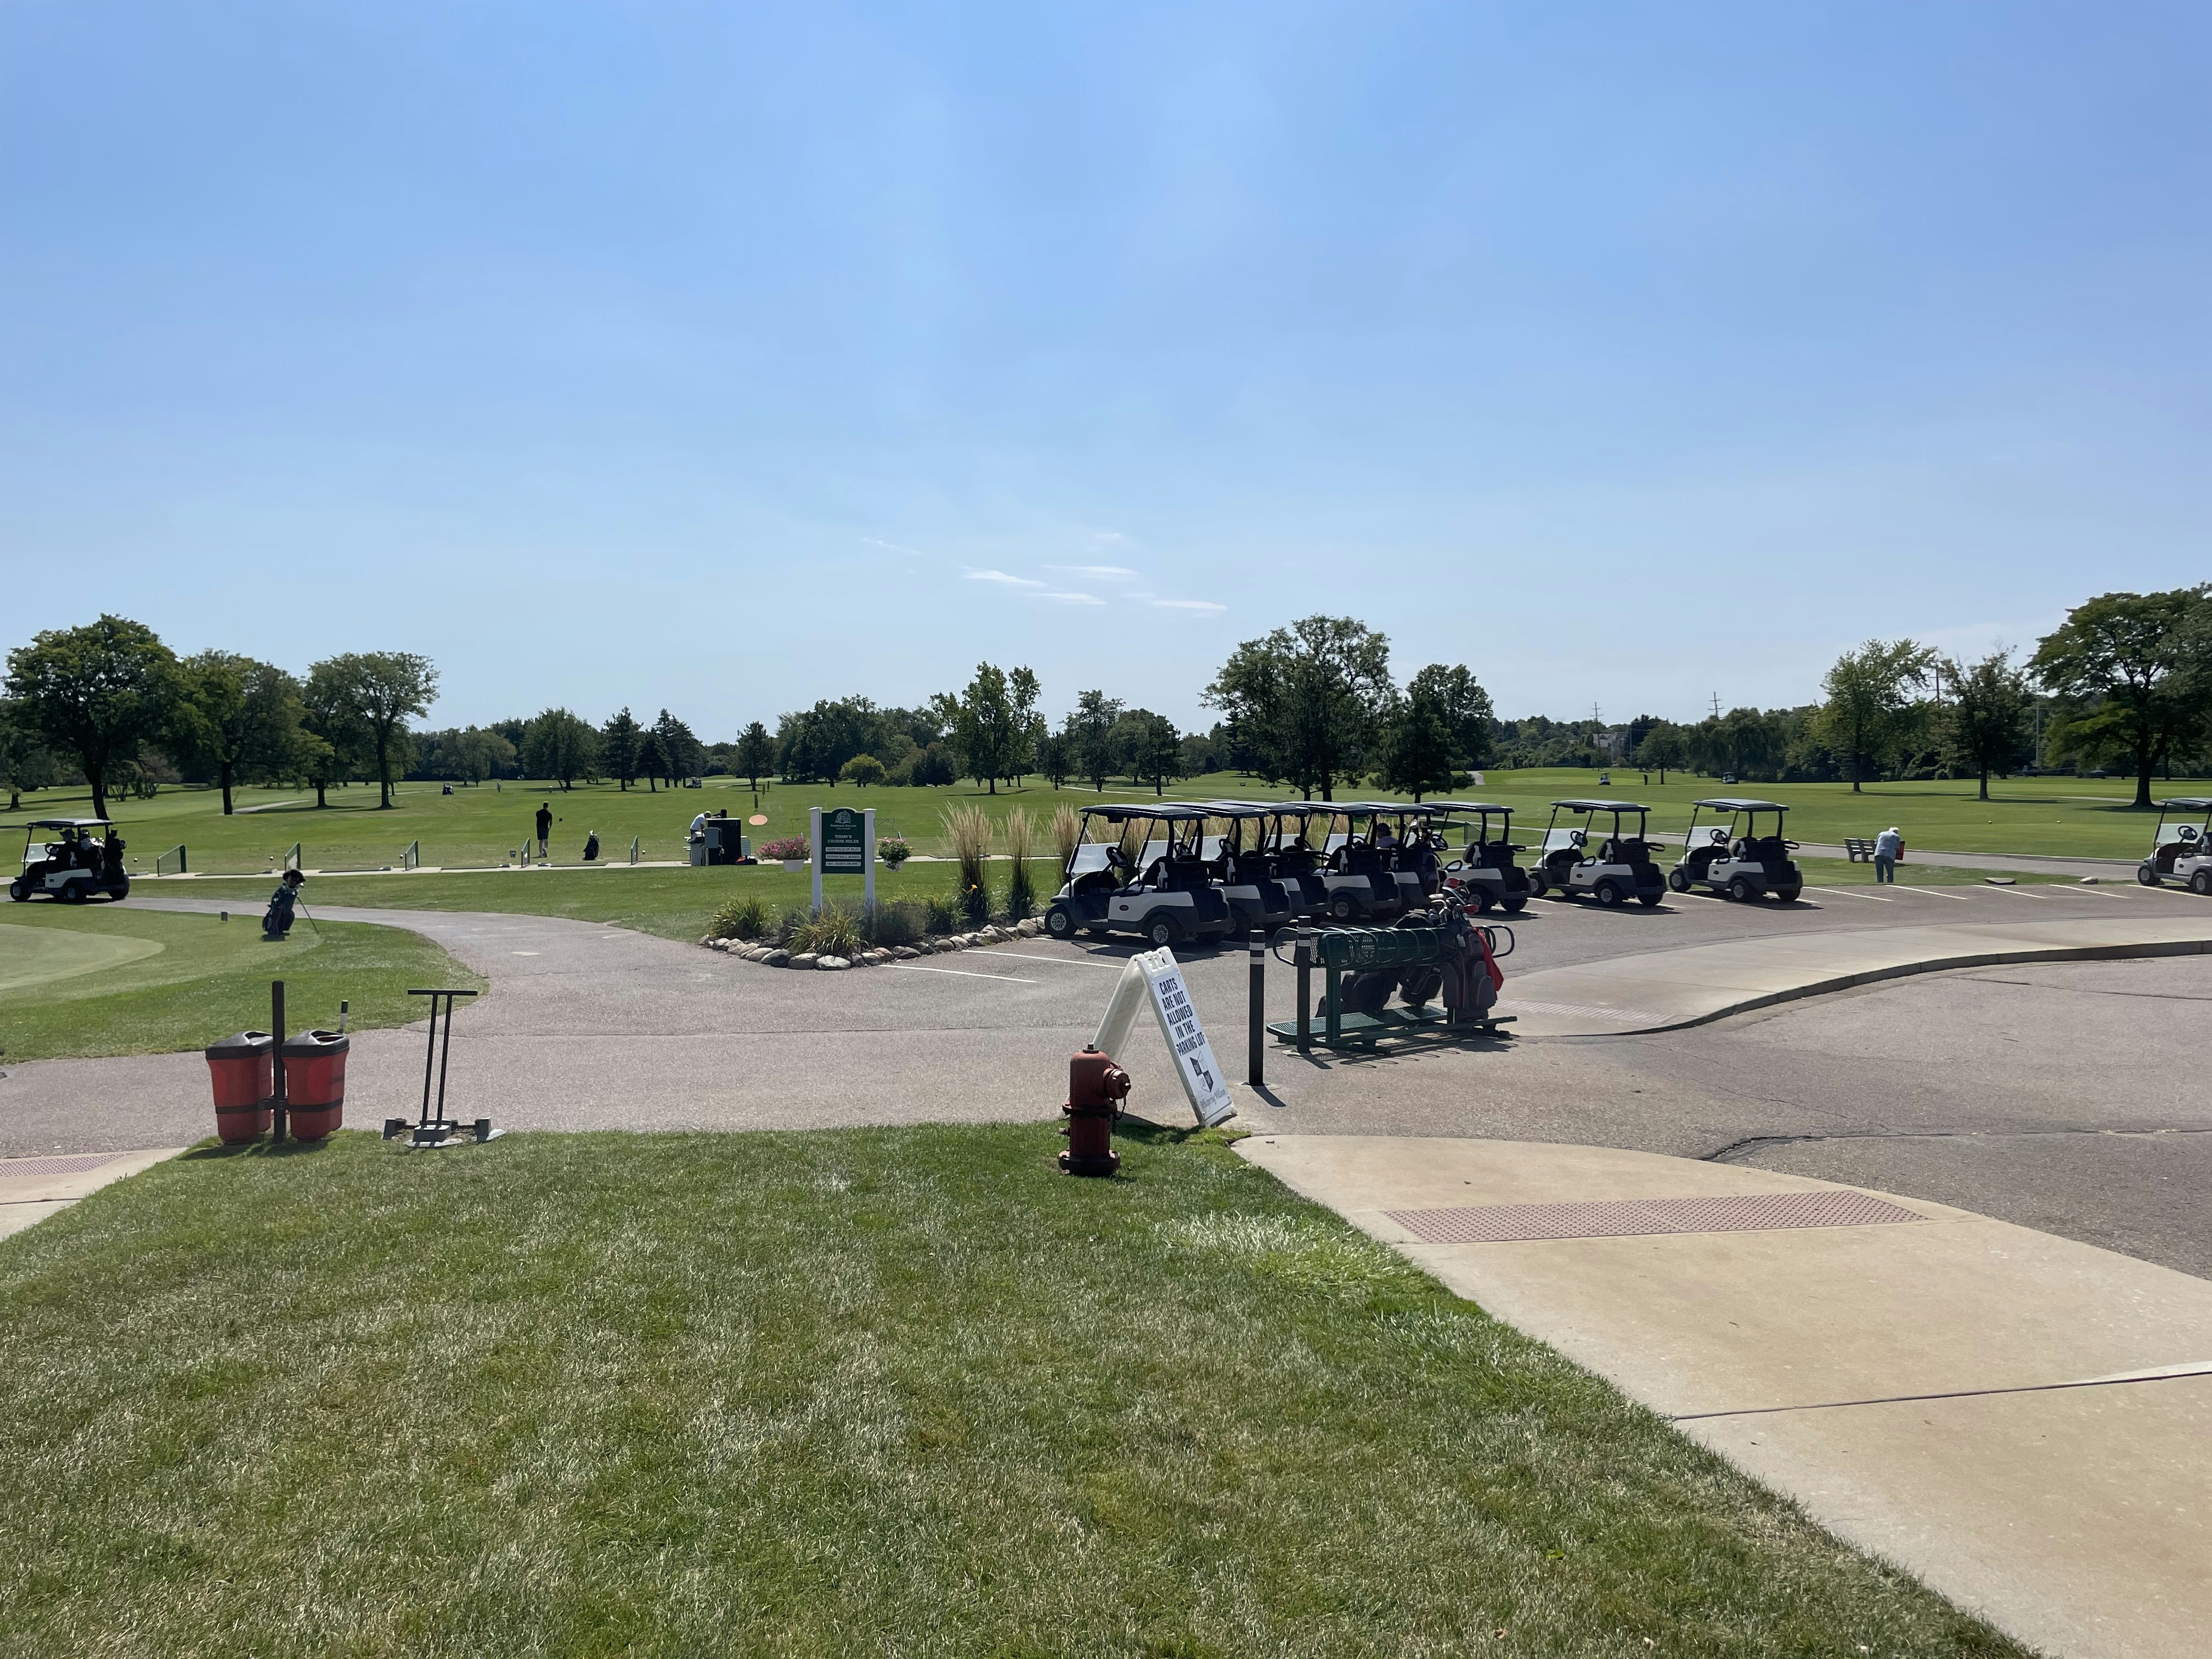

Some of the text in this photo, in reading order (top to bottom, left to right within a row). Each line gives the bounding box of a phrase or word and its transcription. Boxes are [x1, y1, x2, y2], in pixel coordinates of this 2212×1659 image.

[1159, 978, 1178, 995] CARTS
[1162, 991, 1186, 1012] ARE NOT
[1167, 1004, 1193, 1026] ALLOWED
[1175, 1020, 1195, 1039] IN THE
[1176, 1032, 1205, 1057] PARKING LOT
